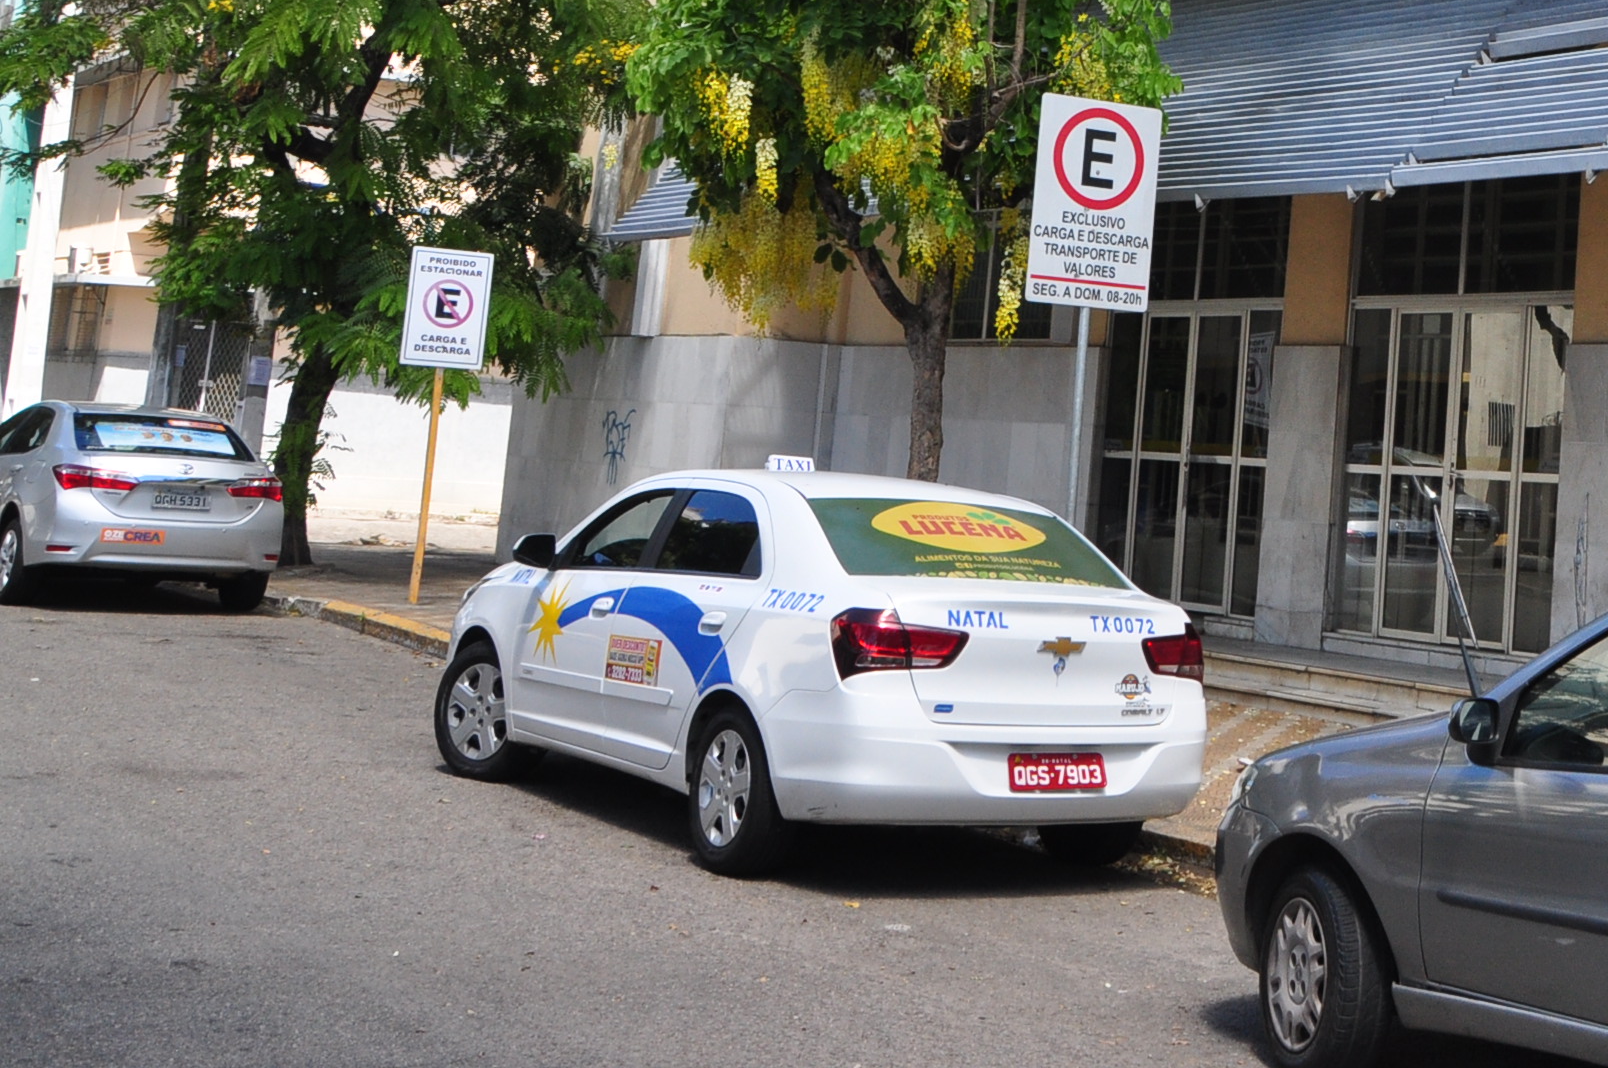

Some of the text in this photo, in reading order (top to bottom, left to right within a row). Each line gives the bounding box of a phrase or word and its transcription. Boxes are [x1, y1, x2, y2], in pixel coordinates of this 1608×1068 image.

[1081, 128, 1117, 189] E
[1062, 211, 1126, 230] EXCLUSIVO
[1034, 225, 1149, 249] CARGA E DESCARGA
[1044, 242, 1138, 264] TRANSPORTE DE
[420, 265, 483, 277] ESTACIONAR
[429, 257, 477, 268] PROIBIDO
[1063, 262, 1116, 279] VALORES
[1032, 283, 1142, 305] SEG. A DOM. 08-20h
[435, 288, 461, 319] E
[421, 334, 467, 345] CARGA E
[414, 344, 471, 356] DESCARGA
[773, 457, 812, 472] TAXI
[912, 514, 969, 522] PRODUTOS
[124, 531, 161, 542] CREA
[899, 520, 1027, 542] LUCENA
[915, 554, 972, 563] ALIMENTOS
[990, 556, 1009, 564] SUA
[1010, 557, 1062, 569] NATUREZA
[948, 610, 1009, 629] NATAL
